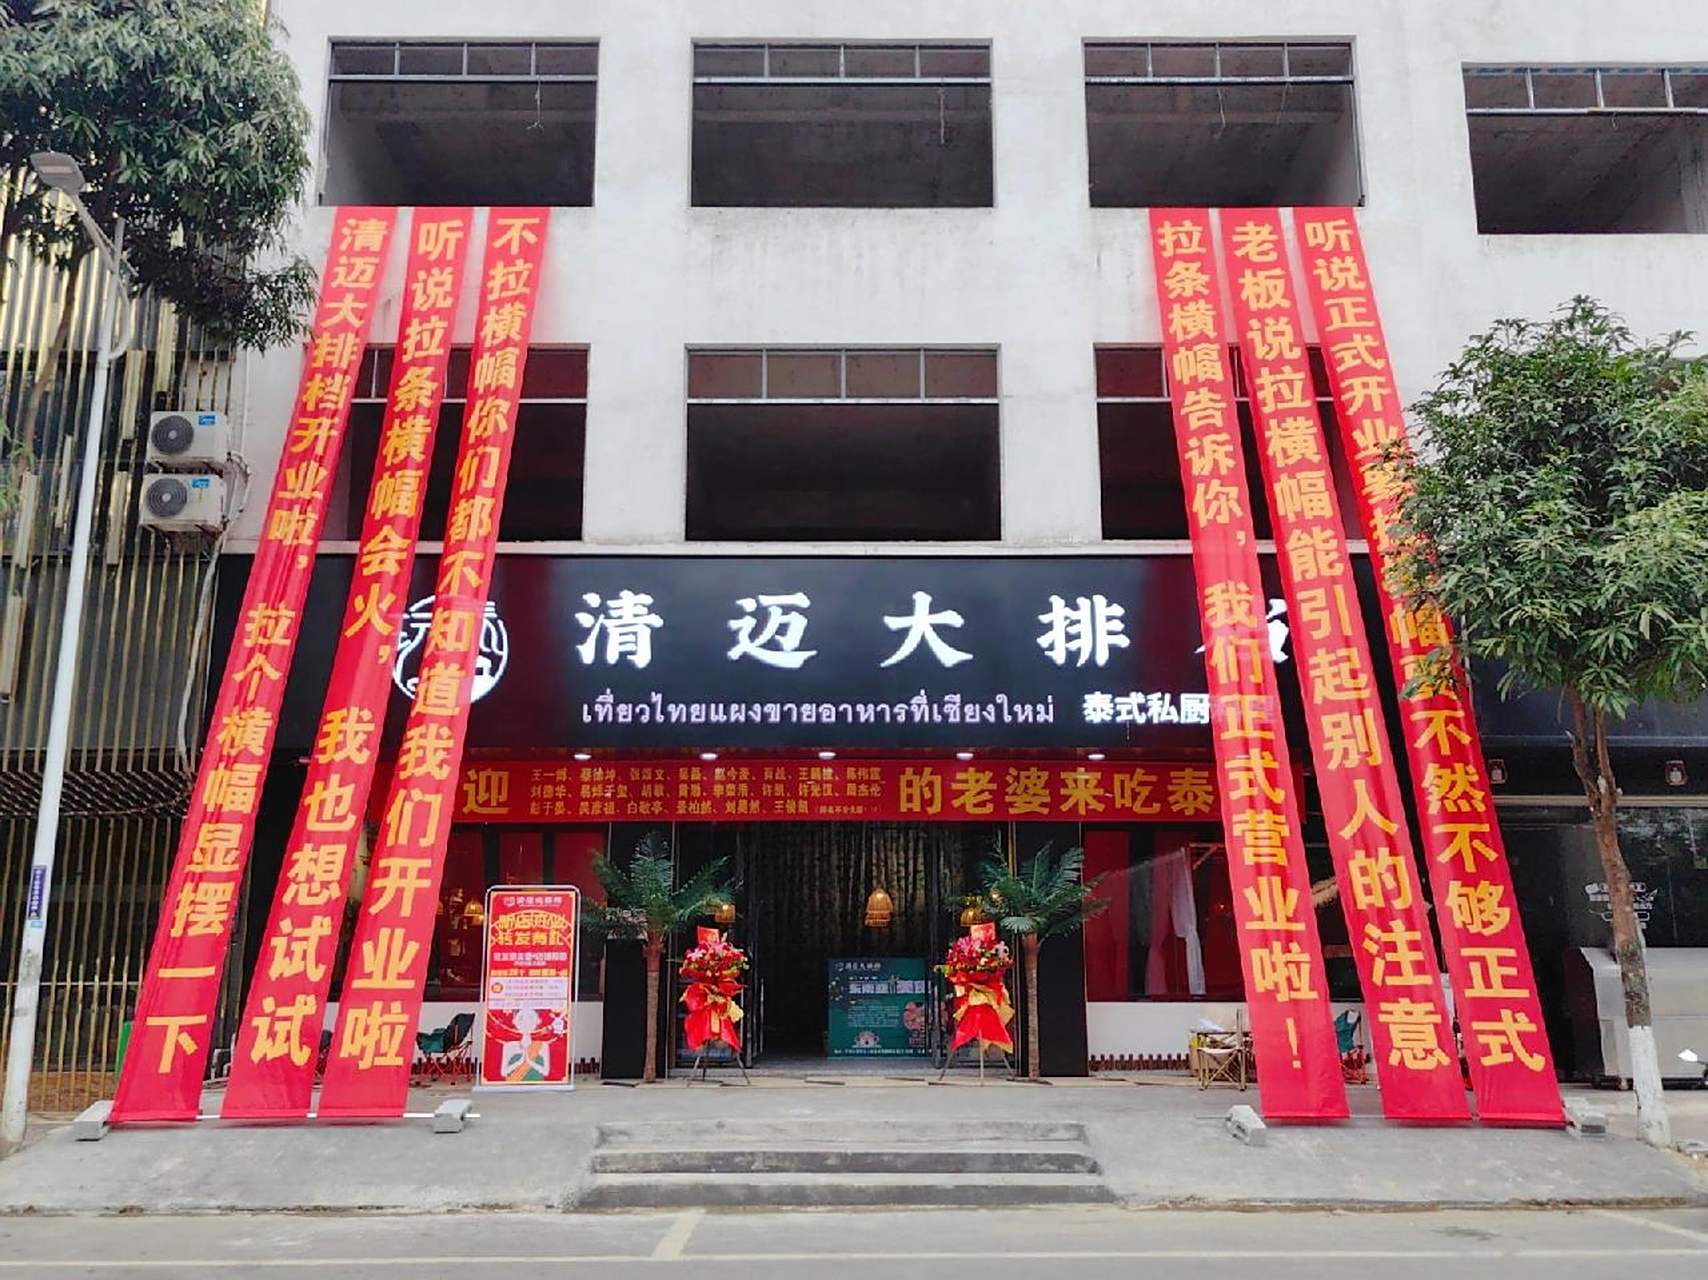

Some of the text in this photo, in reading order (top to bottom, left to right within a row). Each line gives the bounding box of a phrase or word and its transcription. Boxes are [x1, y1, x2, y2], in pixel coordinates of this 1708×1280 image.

[340, 216, 540, 1070] 不拉横幅你们都不知道我们开业啦
[1232, 220, 1450, 1071] 老板说拉横幅能引起别人的注意
[1083, 691, 1210, 724] 泰式私厨
[462, 768, 509, 815] 迎
[899, 767, 1215, 816] 的老婆来吃泰
